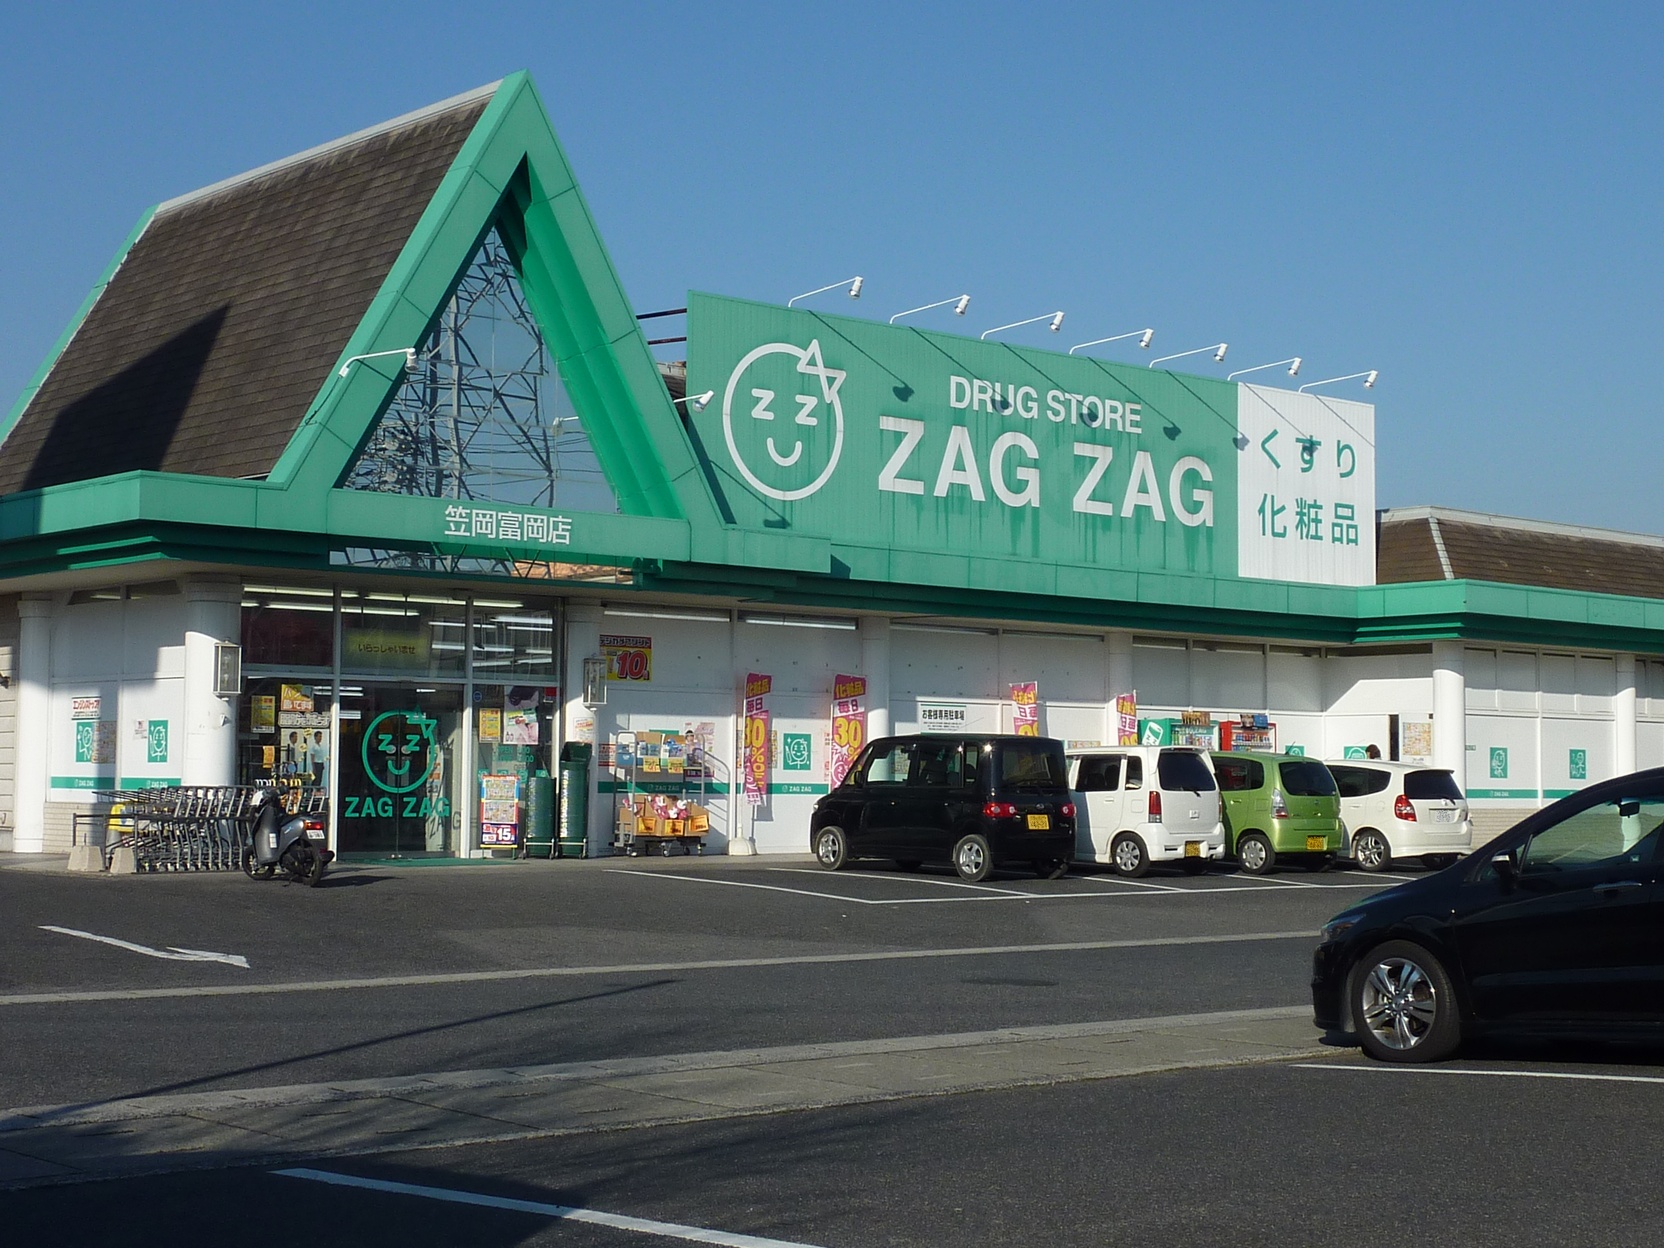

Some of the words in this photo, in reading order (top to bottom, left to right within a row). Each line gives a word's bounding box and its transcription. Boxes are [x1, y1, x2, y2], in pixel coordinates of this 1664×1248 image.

[950, 375, 1039, 419] DRUG
[1046, 390, 1142, 434] STORE
[1260, 428, 1356, 479] くすり
[878, 415, 1040, 508] ZAG
[1073, 442, 1214, 527] ZAG
[444, 504, 573, 545] 笠岡富岡店
[1258, 493, 1359, 546] 化粧品
[746, 697, 763, 713] 毎日
[835, 681, 864, 699] 化粧品
[838, 699, 858, 713] 毎日
[922, 709, 965, 721] お客様専用駐車場
[345, 797, 393, 817] ZAG
[402, 797, 450, 817] ZAG
